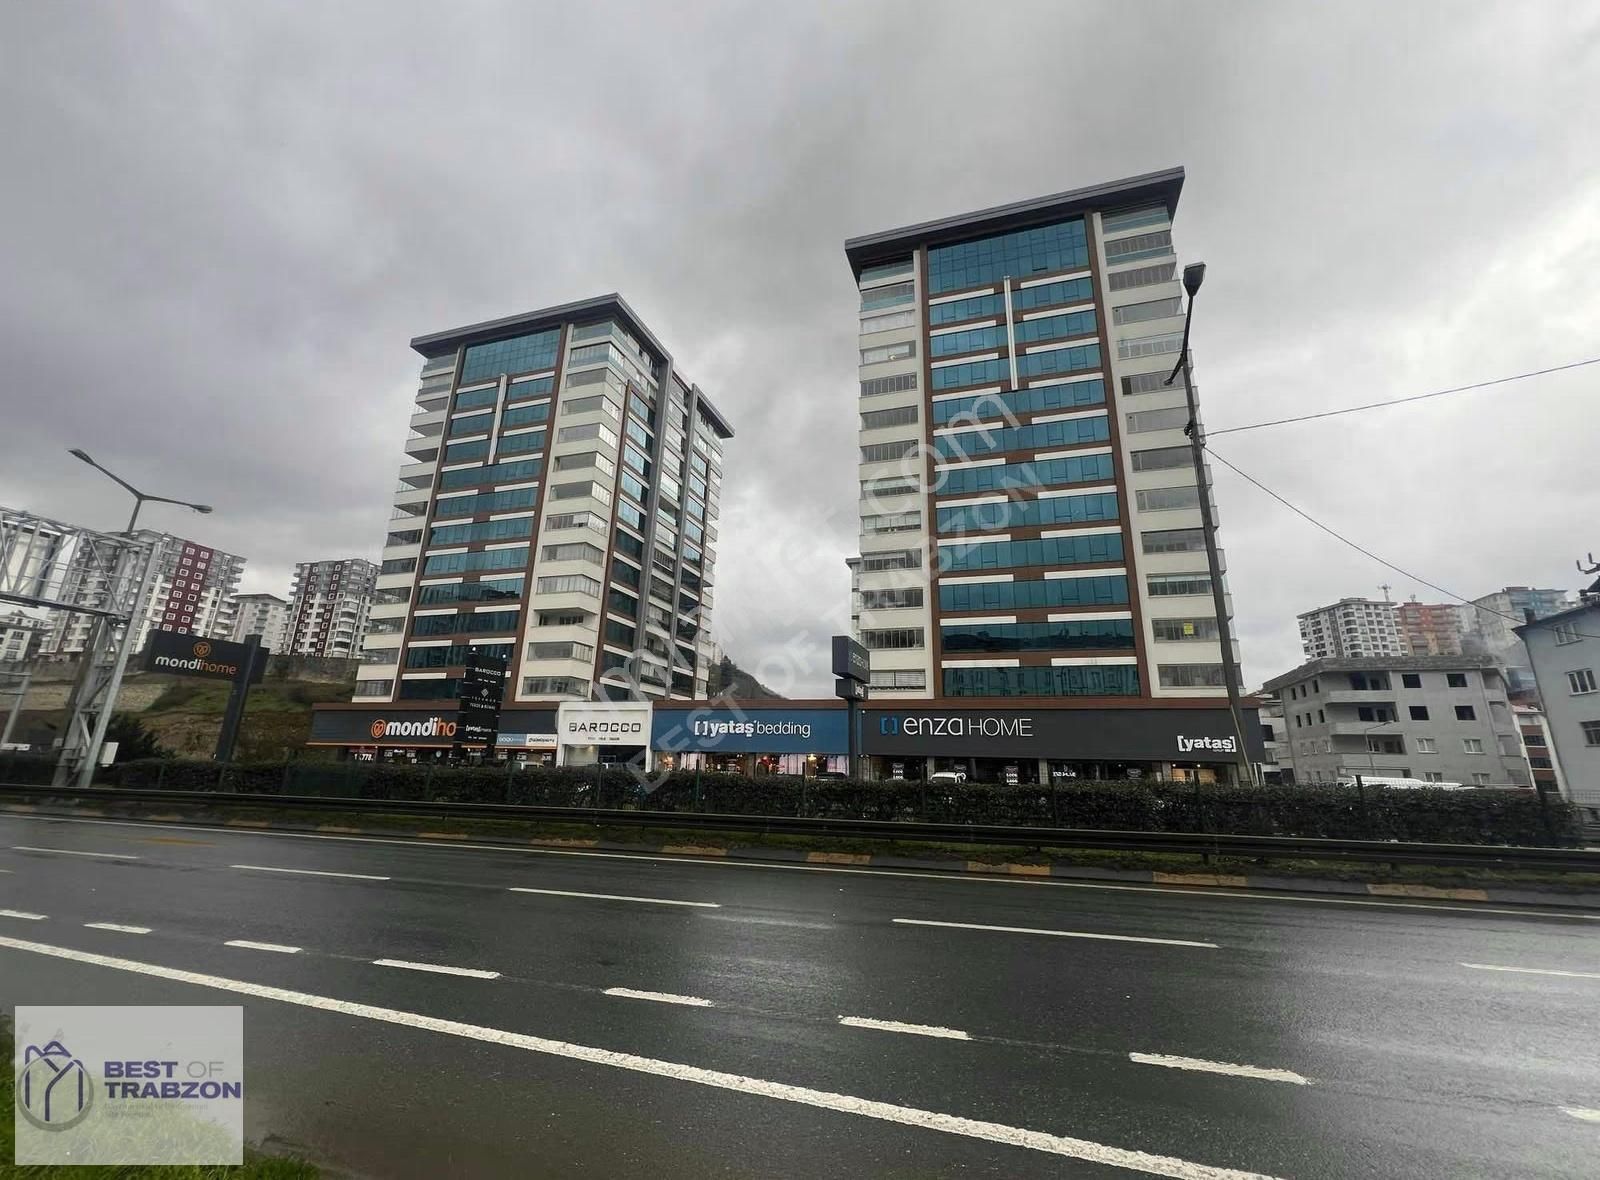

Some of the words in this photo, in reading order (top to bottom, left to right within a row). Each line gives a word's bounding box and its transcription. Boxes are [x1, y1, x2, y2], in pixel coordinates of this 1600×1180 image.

[155, 655, 237, 675] mondihome
[385, 717, 457, 737] mondiho
[569, 722, 642, 733] BAROCCO
[756, 720, 812, 739] bedding
[903, 716, 964, 737] enza
[968, 718, 1034, 737] HOME
